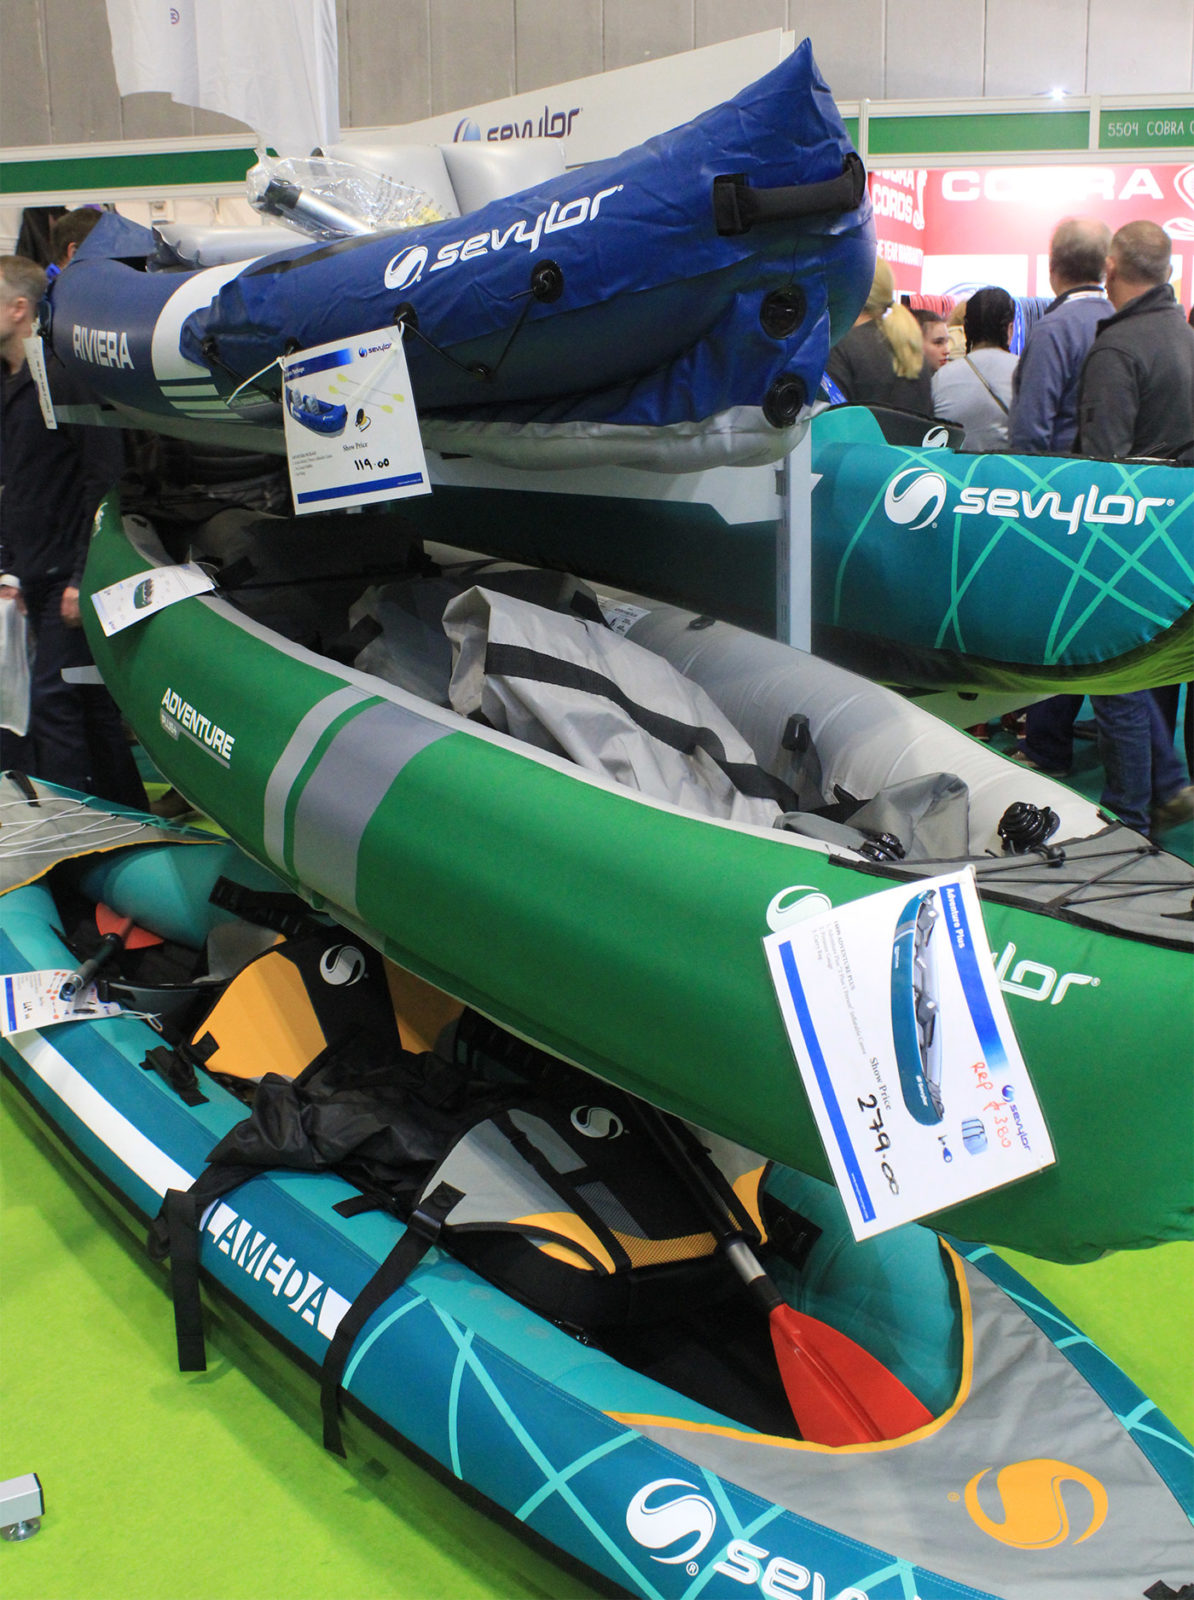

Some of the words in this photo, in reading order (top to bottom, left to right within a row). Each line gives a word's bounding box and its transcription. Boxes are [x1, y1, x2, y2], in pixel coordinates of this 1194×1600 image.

[1107, 122, 1139, 137] 5504
[1146, 120, 1184, 136] COBRA
[429, 187, 619, 272] sevylor
[72, 324, 135, 370] RIVIERA
[953, 484, 1166, 535] sevylor
[161, 687, 236, 760] ADVENTURE
[956, 928, 966, 949] Plus
[870, 1058, 883, 1083] Show
[879, 1085, 891, 1110] Price
[1010, 1104, 1031, 1152] sevylor
[199, 1199, 352, 1341] LAMEDA
